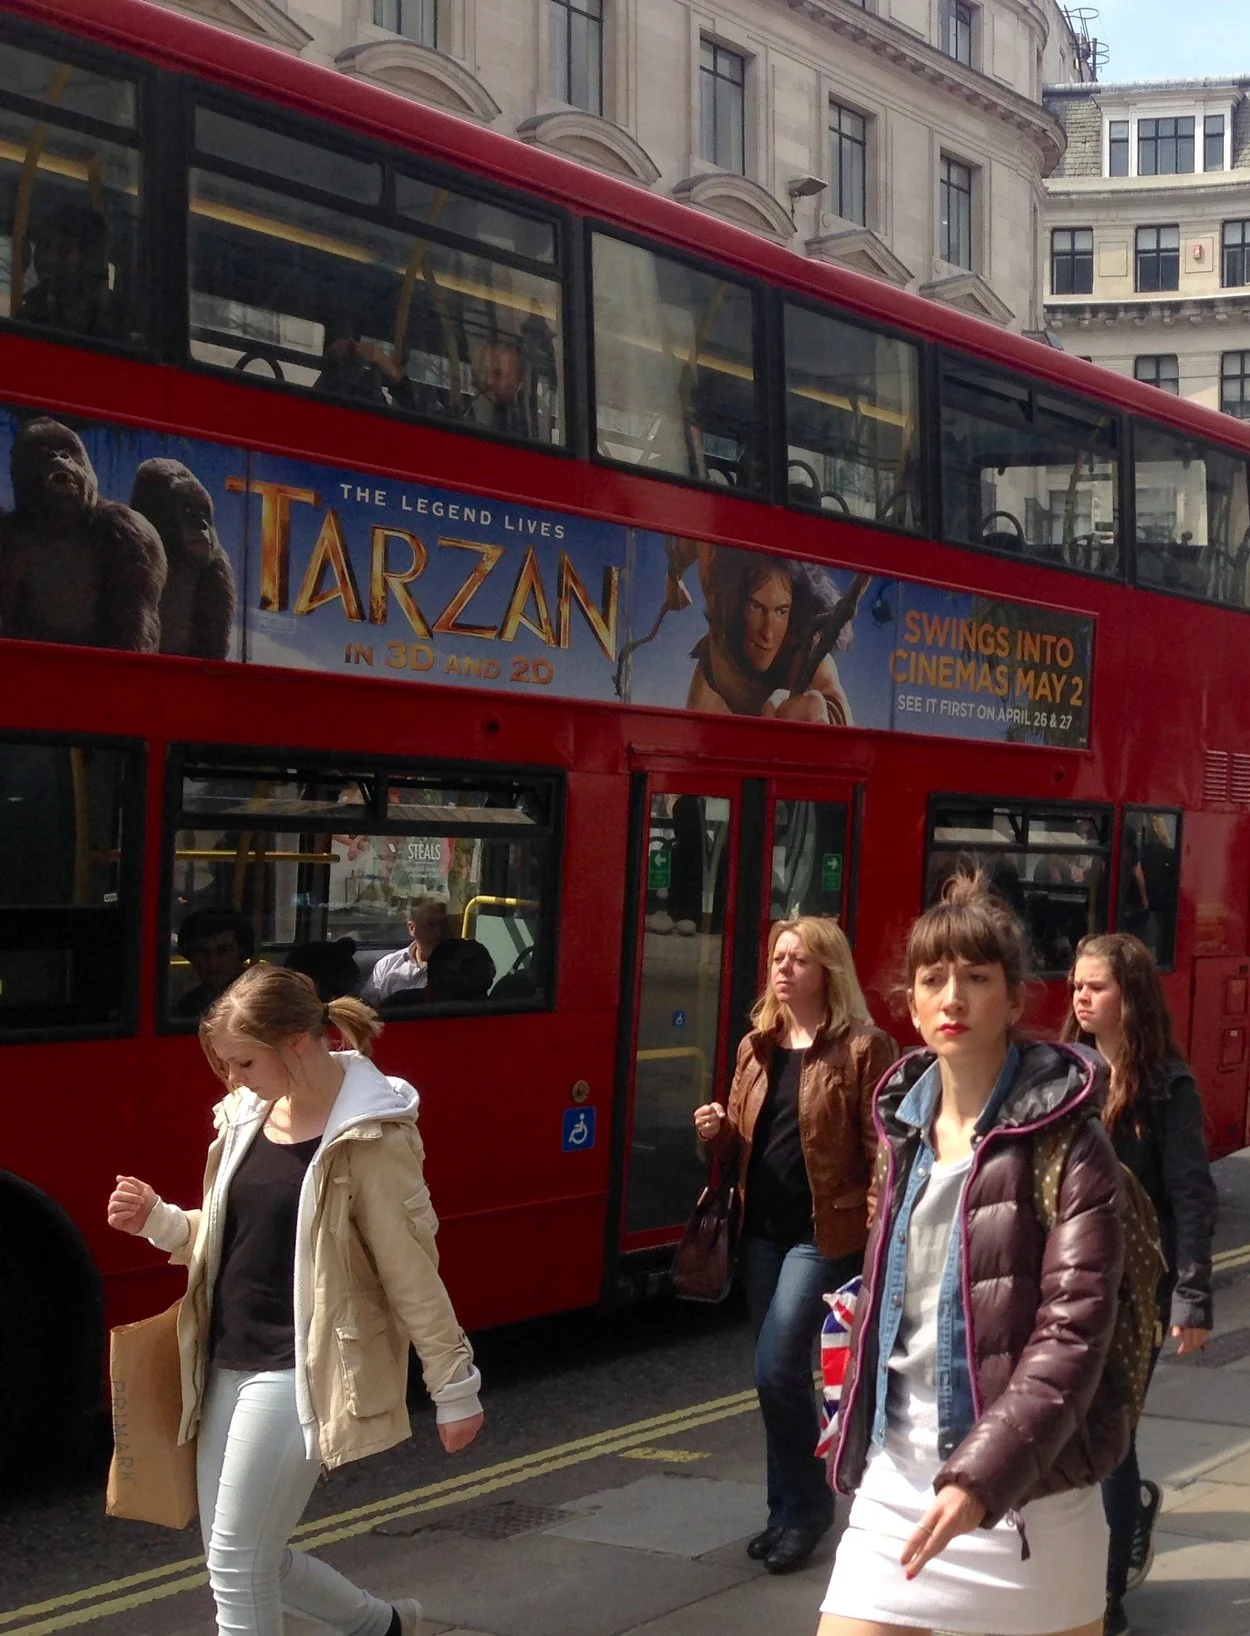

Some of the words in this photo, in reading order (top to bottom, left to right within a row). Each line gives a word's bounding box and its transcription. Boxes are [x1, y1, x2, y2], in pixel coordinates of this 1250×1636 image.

[340, 483, 387, 506] THE
[401, 495, 492, 526] LEGEND
[504, 515, 566, 540] LIVES
[225, 475, 622, 663] TARZAN
[343, 641, 374, 667] IN
[385, 640, 436, 672] 3D
[444, 654, 500, 680] AND
[509, 656, 555, 685] 2D
[904, 609, 1011, 658] SWINGS
[1016, 629, 1074, 669] INTO
[889, 648, 1009, 697] CINEMAS
[1015, 667, 1067, 704] MAY
[1070, 676, 1084, 707] 2
[898, 694, 922, 713] SEE
[925, 697, 938, 712] IT
[940, 699, 976, 718] FIRST
[977, 703, 995, 721] ON
[997, 706, 1030, 726] APRIL
[1034, 711, 1047, 728] 26
[1049, 715, 1057, 728] &
[1059, 714, 1073, 730] 27
[408, 843, 440, 861] STEALS
[112, 1380, 136, 1486] PRIMARK
